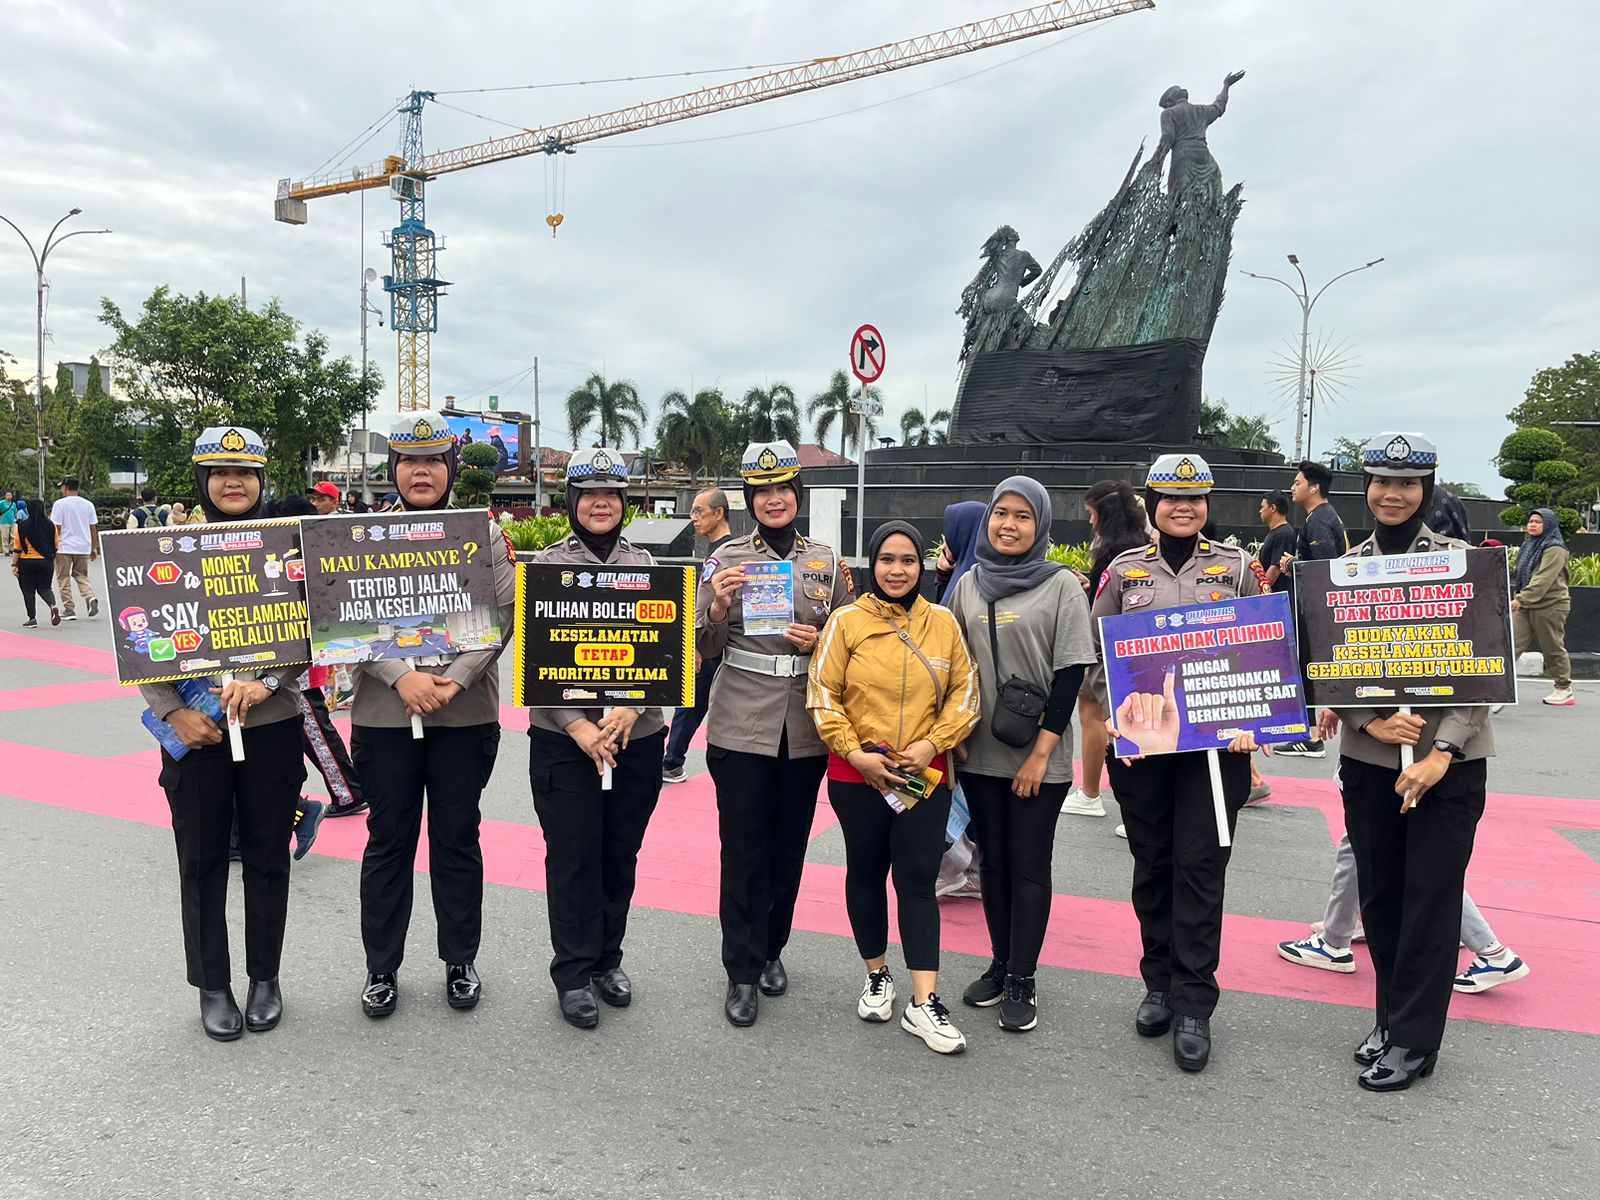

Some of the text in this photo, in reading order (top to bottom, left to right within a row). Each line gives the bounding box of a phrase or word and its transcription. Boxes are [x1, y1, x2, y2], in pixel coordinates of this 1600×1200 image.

[200, 531, 262, 545] DITLANTAS
[389, 522, 443, 534] DITLANTAS
[201, 554, 251, 577] MONEY
[320, 542, 478, 573] MAU KAMPANYE ?
[1385, 555, 1450, 569] DITLANTAS
[116, 565, 201, 590] SAY NO to
[204, 574, 260, 597] POLITIK
[348, 572, 462, 599] TERTIB DI JALAN,
[596, 572, 650, 582] DITLANTAS
[803, 573, 833, 584] POLRI
[1122, 579, 1155, 589] RESTU
[1196, 576, 1234, 586] POLRI
[1327, 583, 1474, 607] PILKADA DAMAI
[161, 601, 200, 632] SAY
[207, 600, 308, 629] KESELAMATAN
[339, 593, 472, 622] JAGA KESELAMATAN
[535, 600, 674, 620] PILIHAN BOLEH BEDA
[1334, 601, 1467, 623] DAN KONDUSIF
[174, 624, 210, 649] YES to
[211, 623, 275, 650] BERLALU
[550, 629, 659, 643] KESELAMATAN
[1115, 622, 1285, 658] BERIKAN HAK PILIHMU
[1344, 623, 1457, 643] BUDAYAKAN
[581, 649, 629, 661] TETAP
[1332, 641, 1473, 661] KESELAMATAN
[539, 667, 668, 681] PRORITAS UTAMA
[1181, 658, 1230, 676] JANGAN
[1307, 657, 1505, 679] SEBAGAI KEBUTUHAN
[1183, 669, 1281, 692] MENGGUNAKAN
[1185, 684, 1297, 708] HANDPHONE SAAT
[1187, 703, 1272, 724] BERKENDARA
